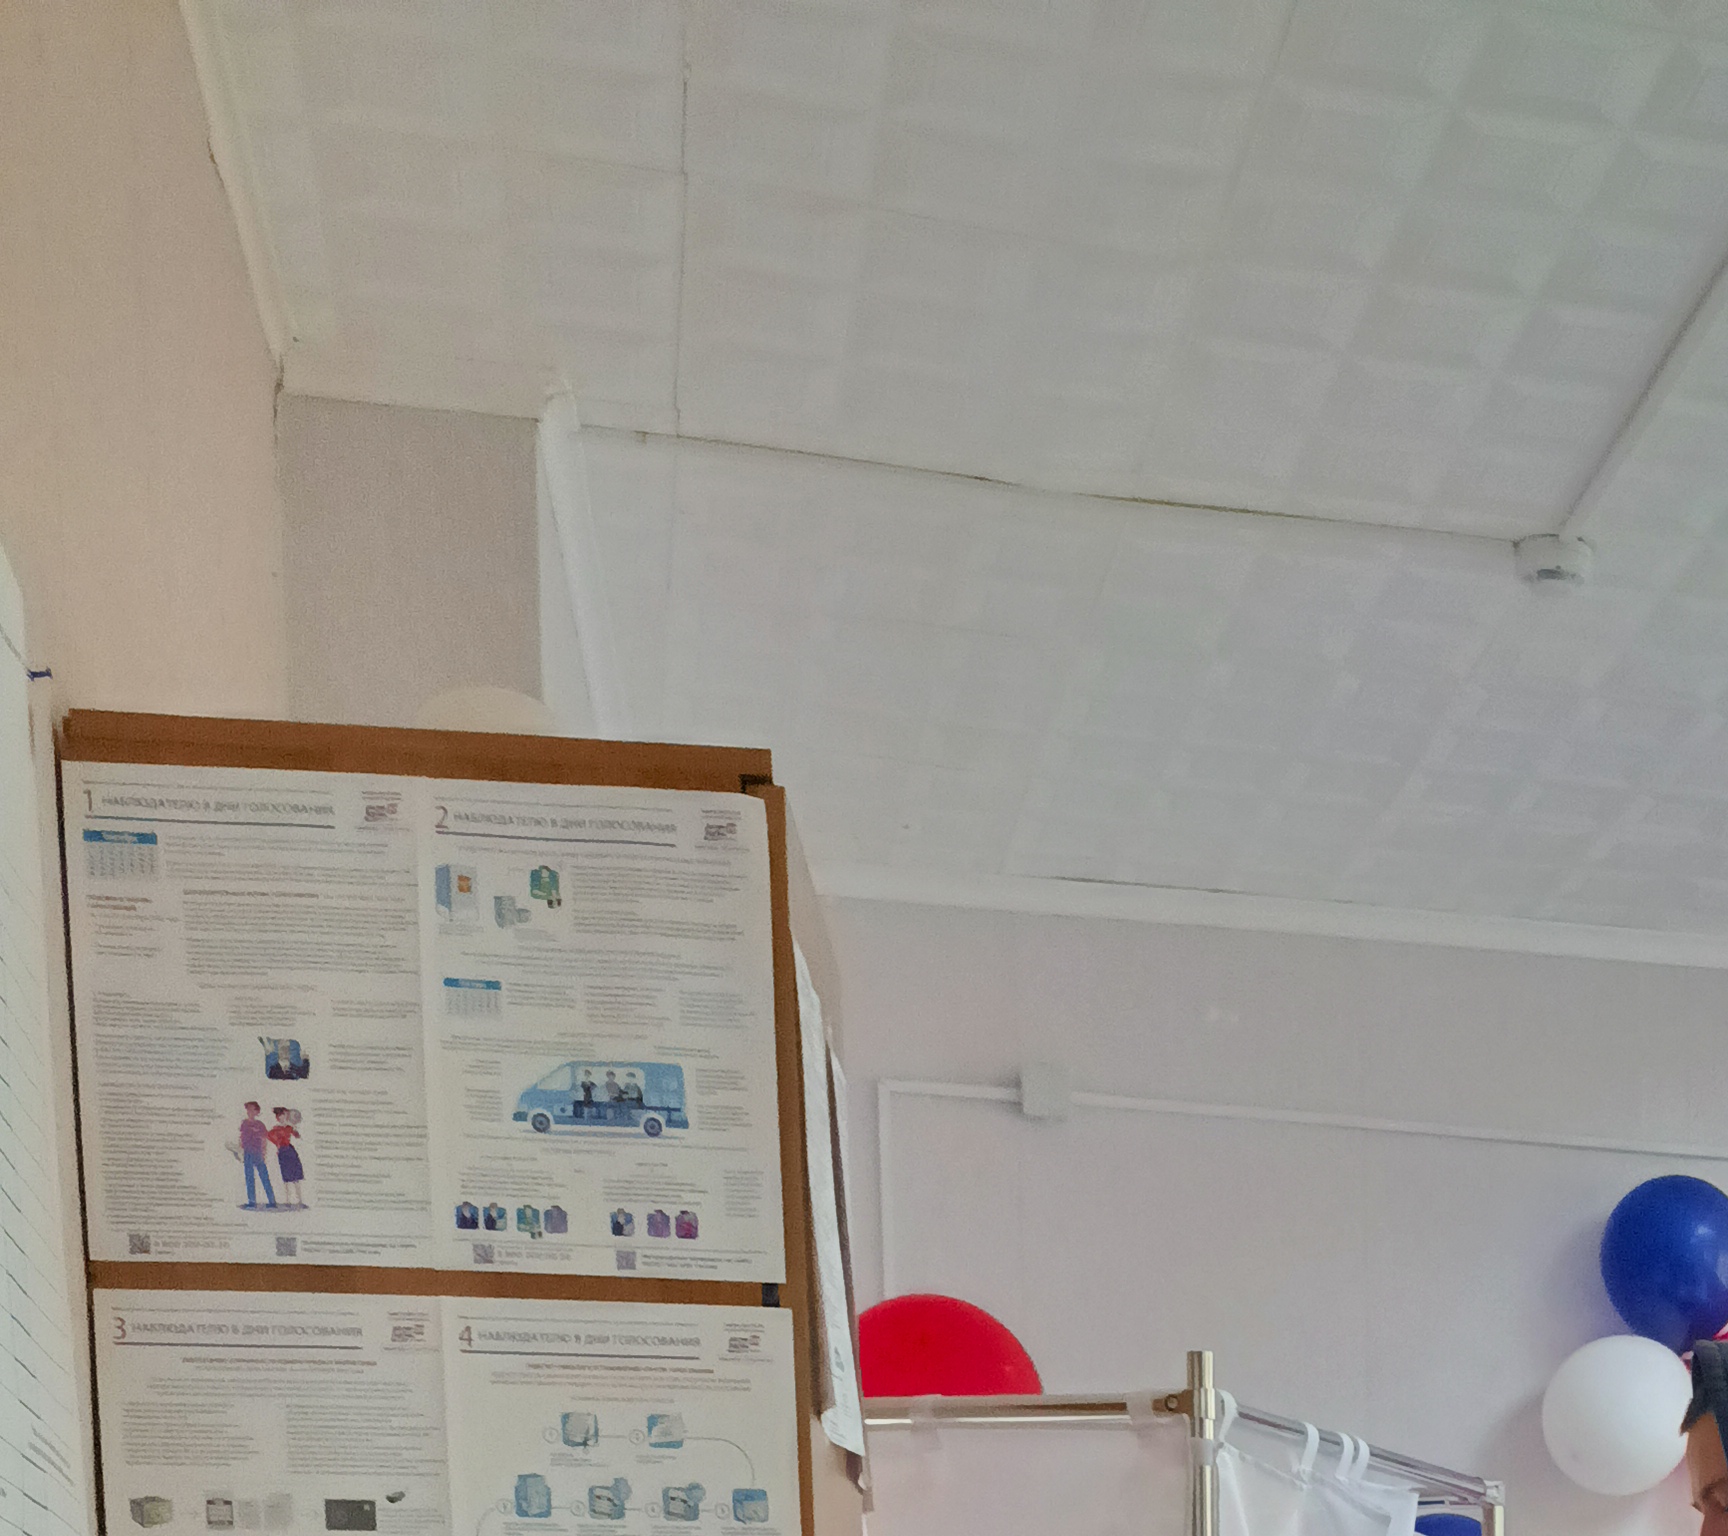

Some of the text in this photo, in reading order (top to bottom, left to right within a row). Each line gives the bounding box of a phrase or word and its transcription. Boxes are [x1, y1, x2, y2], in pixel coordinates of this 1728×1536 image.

[83, 789, 92, 811] 1
[434, 805, 449, 829] 2
[113, 1317, 126, 1339] 3
[459, 1325, 473, 1348] 4
